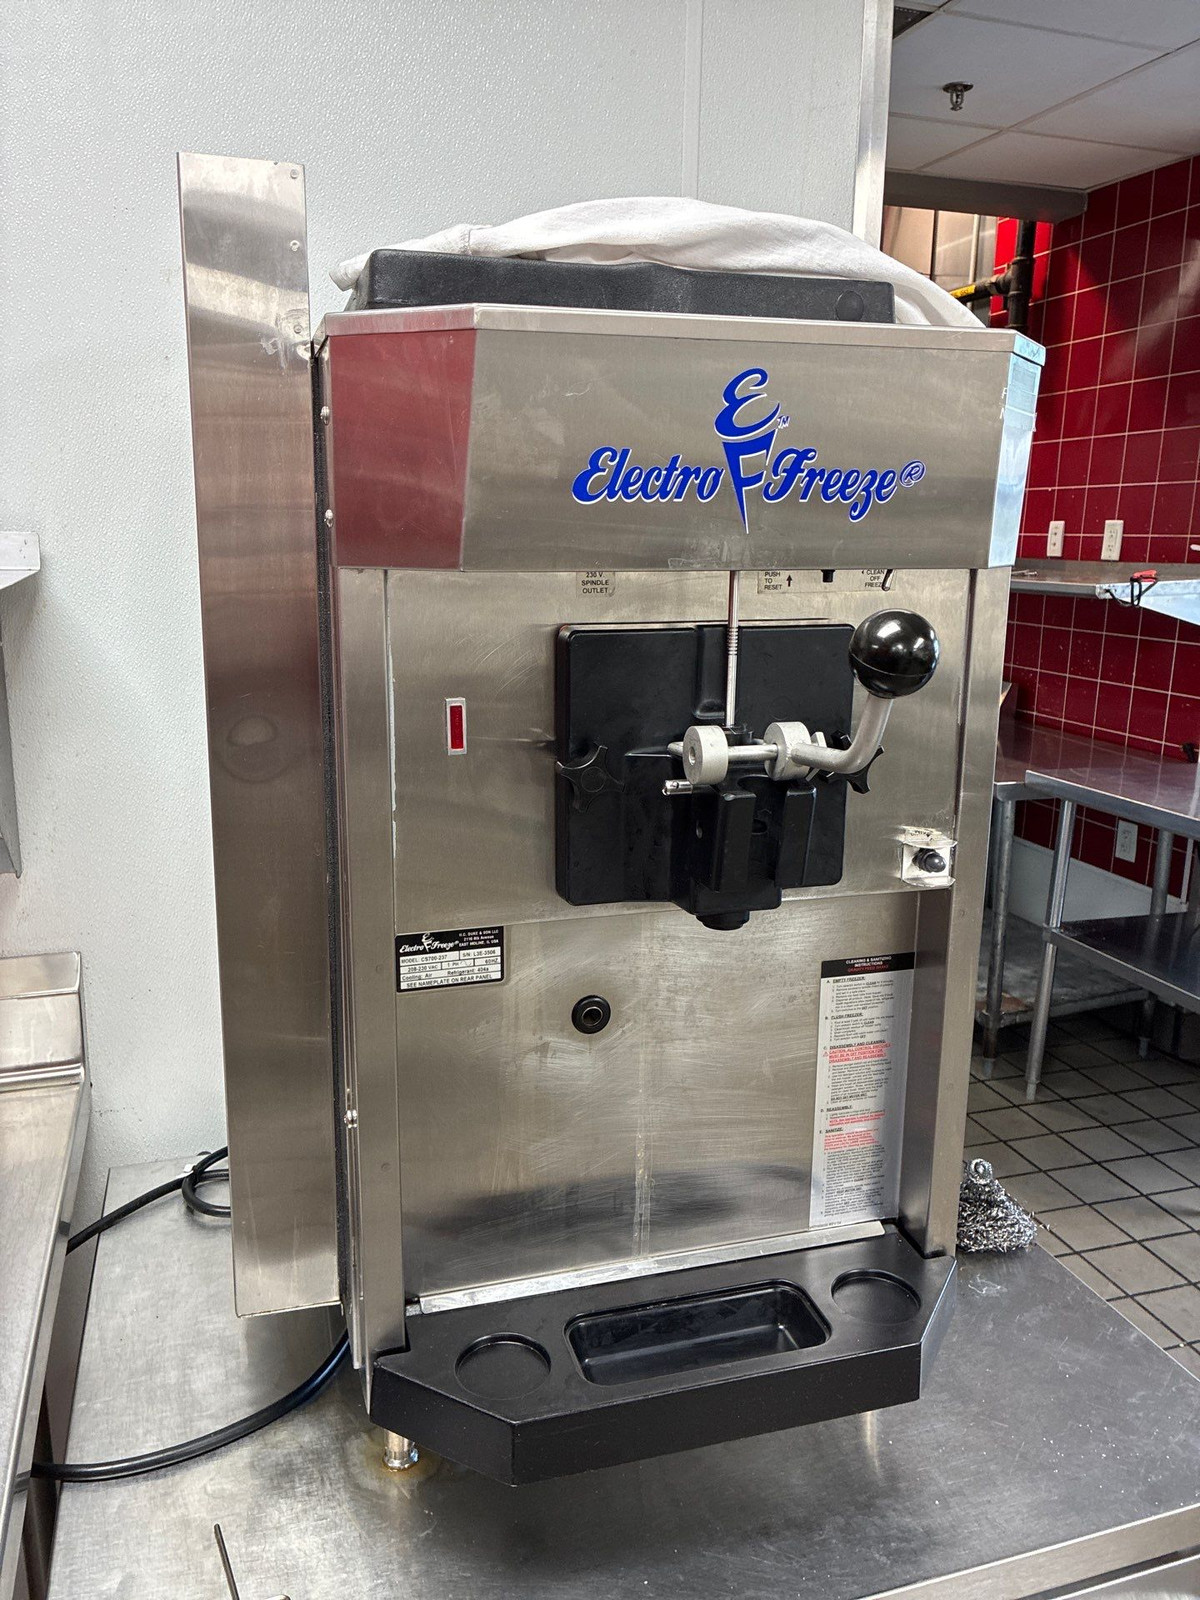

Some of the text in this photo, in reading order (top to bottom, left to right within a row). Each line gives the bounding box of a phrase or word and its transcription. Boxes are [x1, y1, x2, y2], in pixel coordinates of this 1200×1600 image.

[571, 446, 725, 504] Electro
[399, 944, 424, 953] Electro
[418, 977, 450, 987] NAMEPLATE
